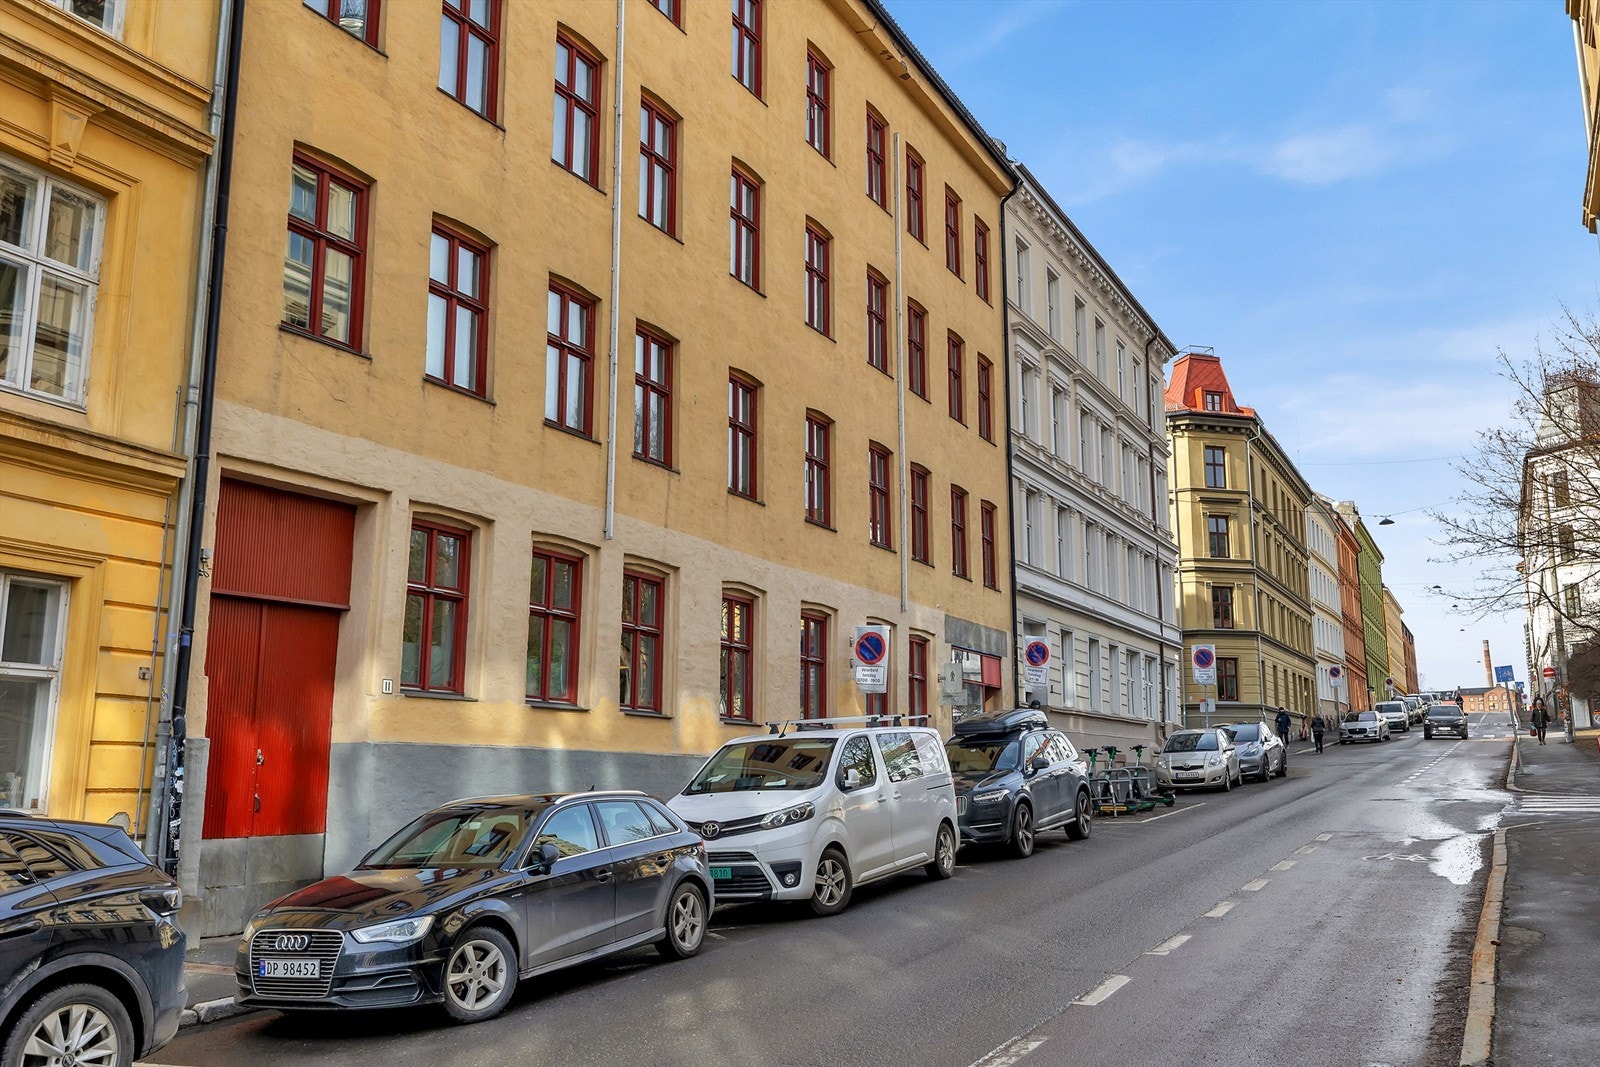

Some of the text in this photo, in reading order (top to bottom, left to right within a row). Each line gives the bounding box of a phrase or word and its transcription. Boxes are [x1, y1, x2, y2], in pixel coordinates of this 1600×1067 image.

[385, 681, 390, 691] 11
[267, 962, 316, 976] DP 98452
